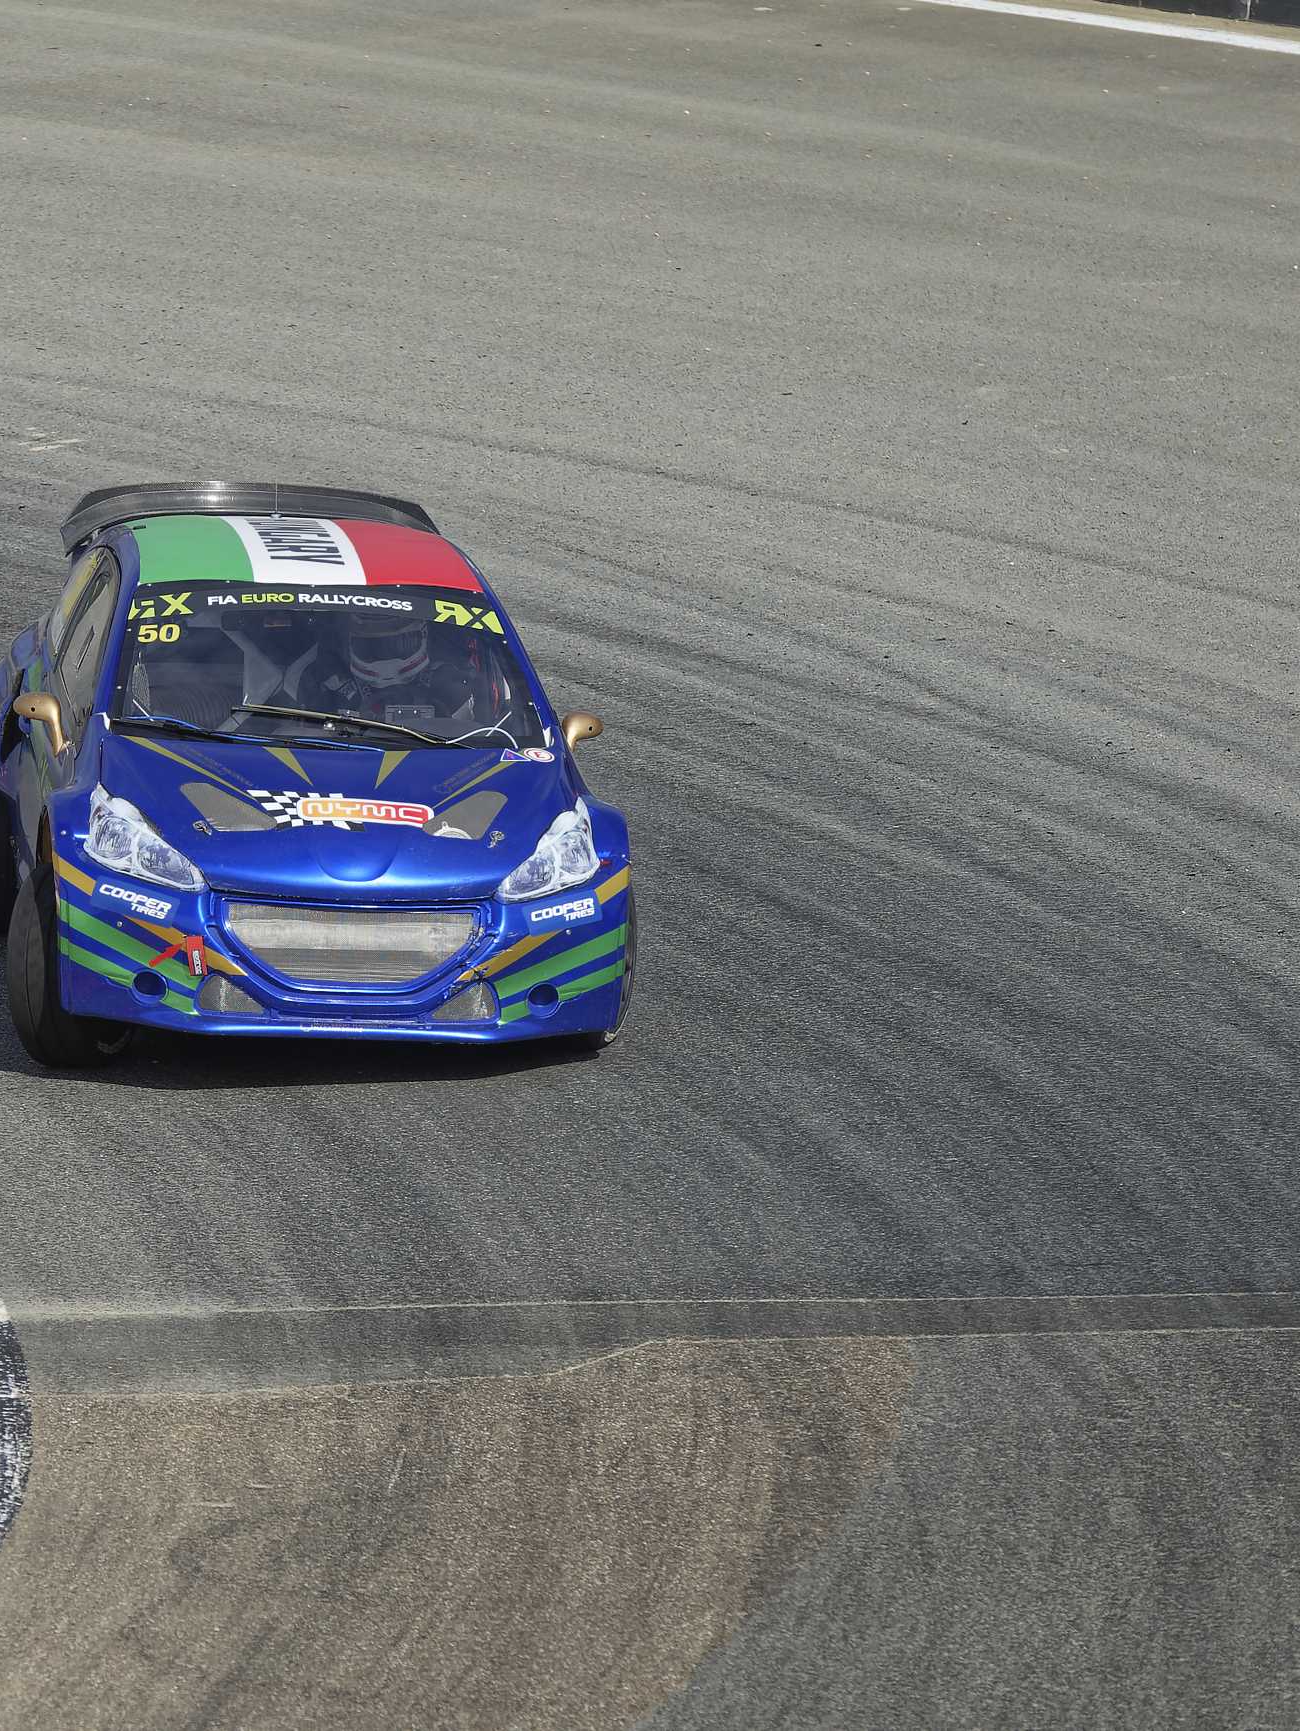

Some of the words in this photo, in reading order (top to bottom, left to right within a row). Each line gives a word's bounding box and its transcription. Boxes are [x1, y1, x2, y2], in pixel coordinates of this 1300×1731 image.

[207, 594, 238, 606] FIA
[241, 593, 294, 604] EURO
[298, 593, 413, 611] RALLYCROSS
[138, 623, 180, 643] 50
[307, 802, 425, 821] NYMC
[99, 884, 172, 913] COOPER
[131, 903, 167, 920] TIRES
[531, 898, 594, 921] COOPER
[564, 908, 595, 921] TIRES
